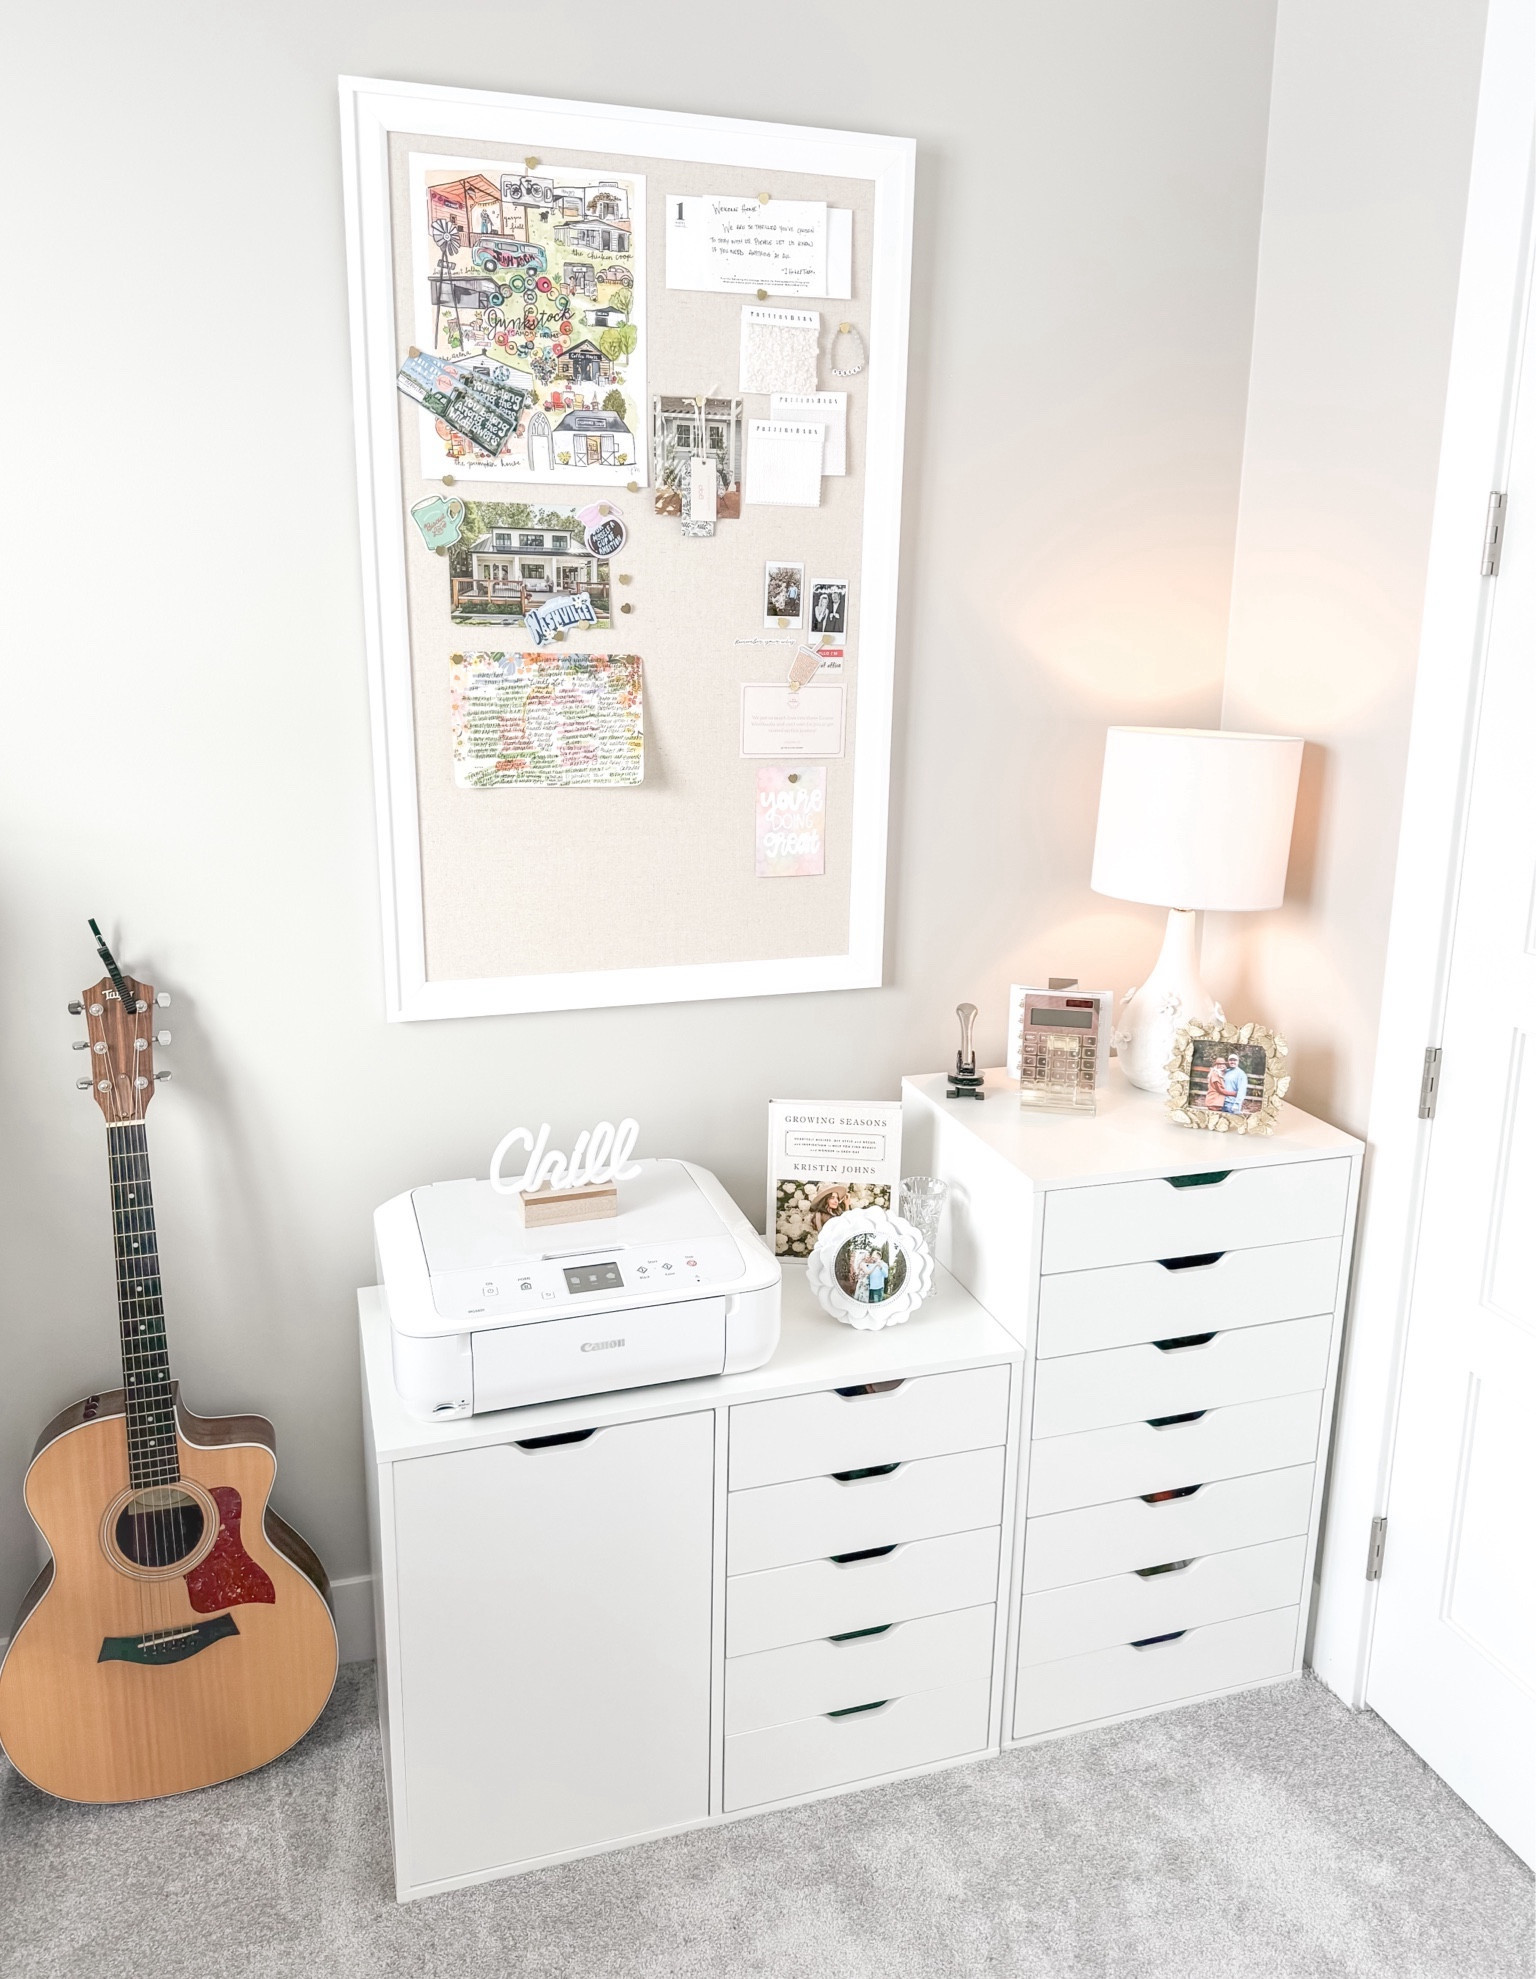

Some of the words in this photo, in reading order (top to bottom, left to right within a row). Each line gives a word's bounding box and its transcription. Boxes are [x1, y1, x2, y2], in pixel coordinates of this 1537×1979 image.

[676, 202, 685, 221] 1
[487, 303, 575, 340] Junkstock
[485, 421, 498, 434] the
[771, 813, 814, 830] DOING
[763, 829, 820, 859] great
[102, 989, 134, 1001] Tayr
[785, 1115, 835, 1125] GROWING
[839, 1118, 888, 1127] SEASONS
[489, 1117, 643, 1195] Chill
[793, 1163, 837, 1172] KRISTIN
[842, 1166, 876, 1175] JOHNS
[580, 1338, 626, 1353] Canon
